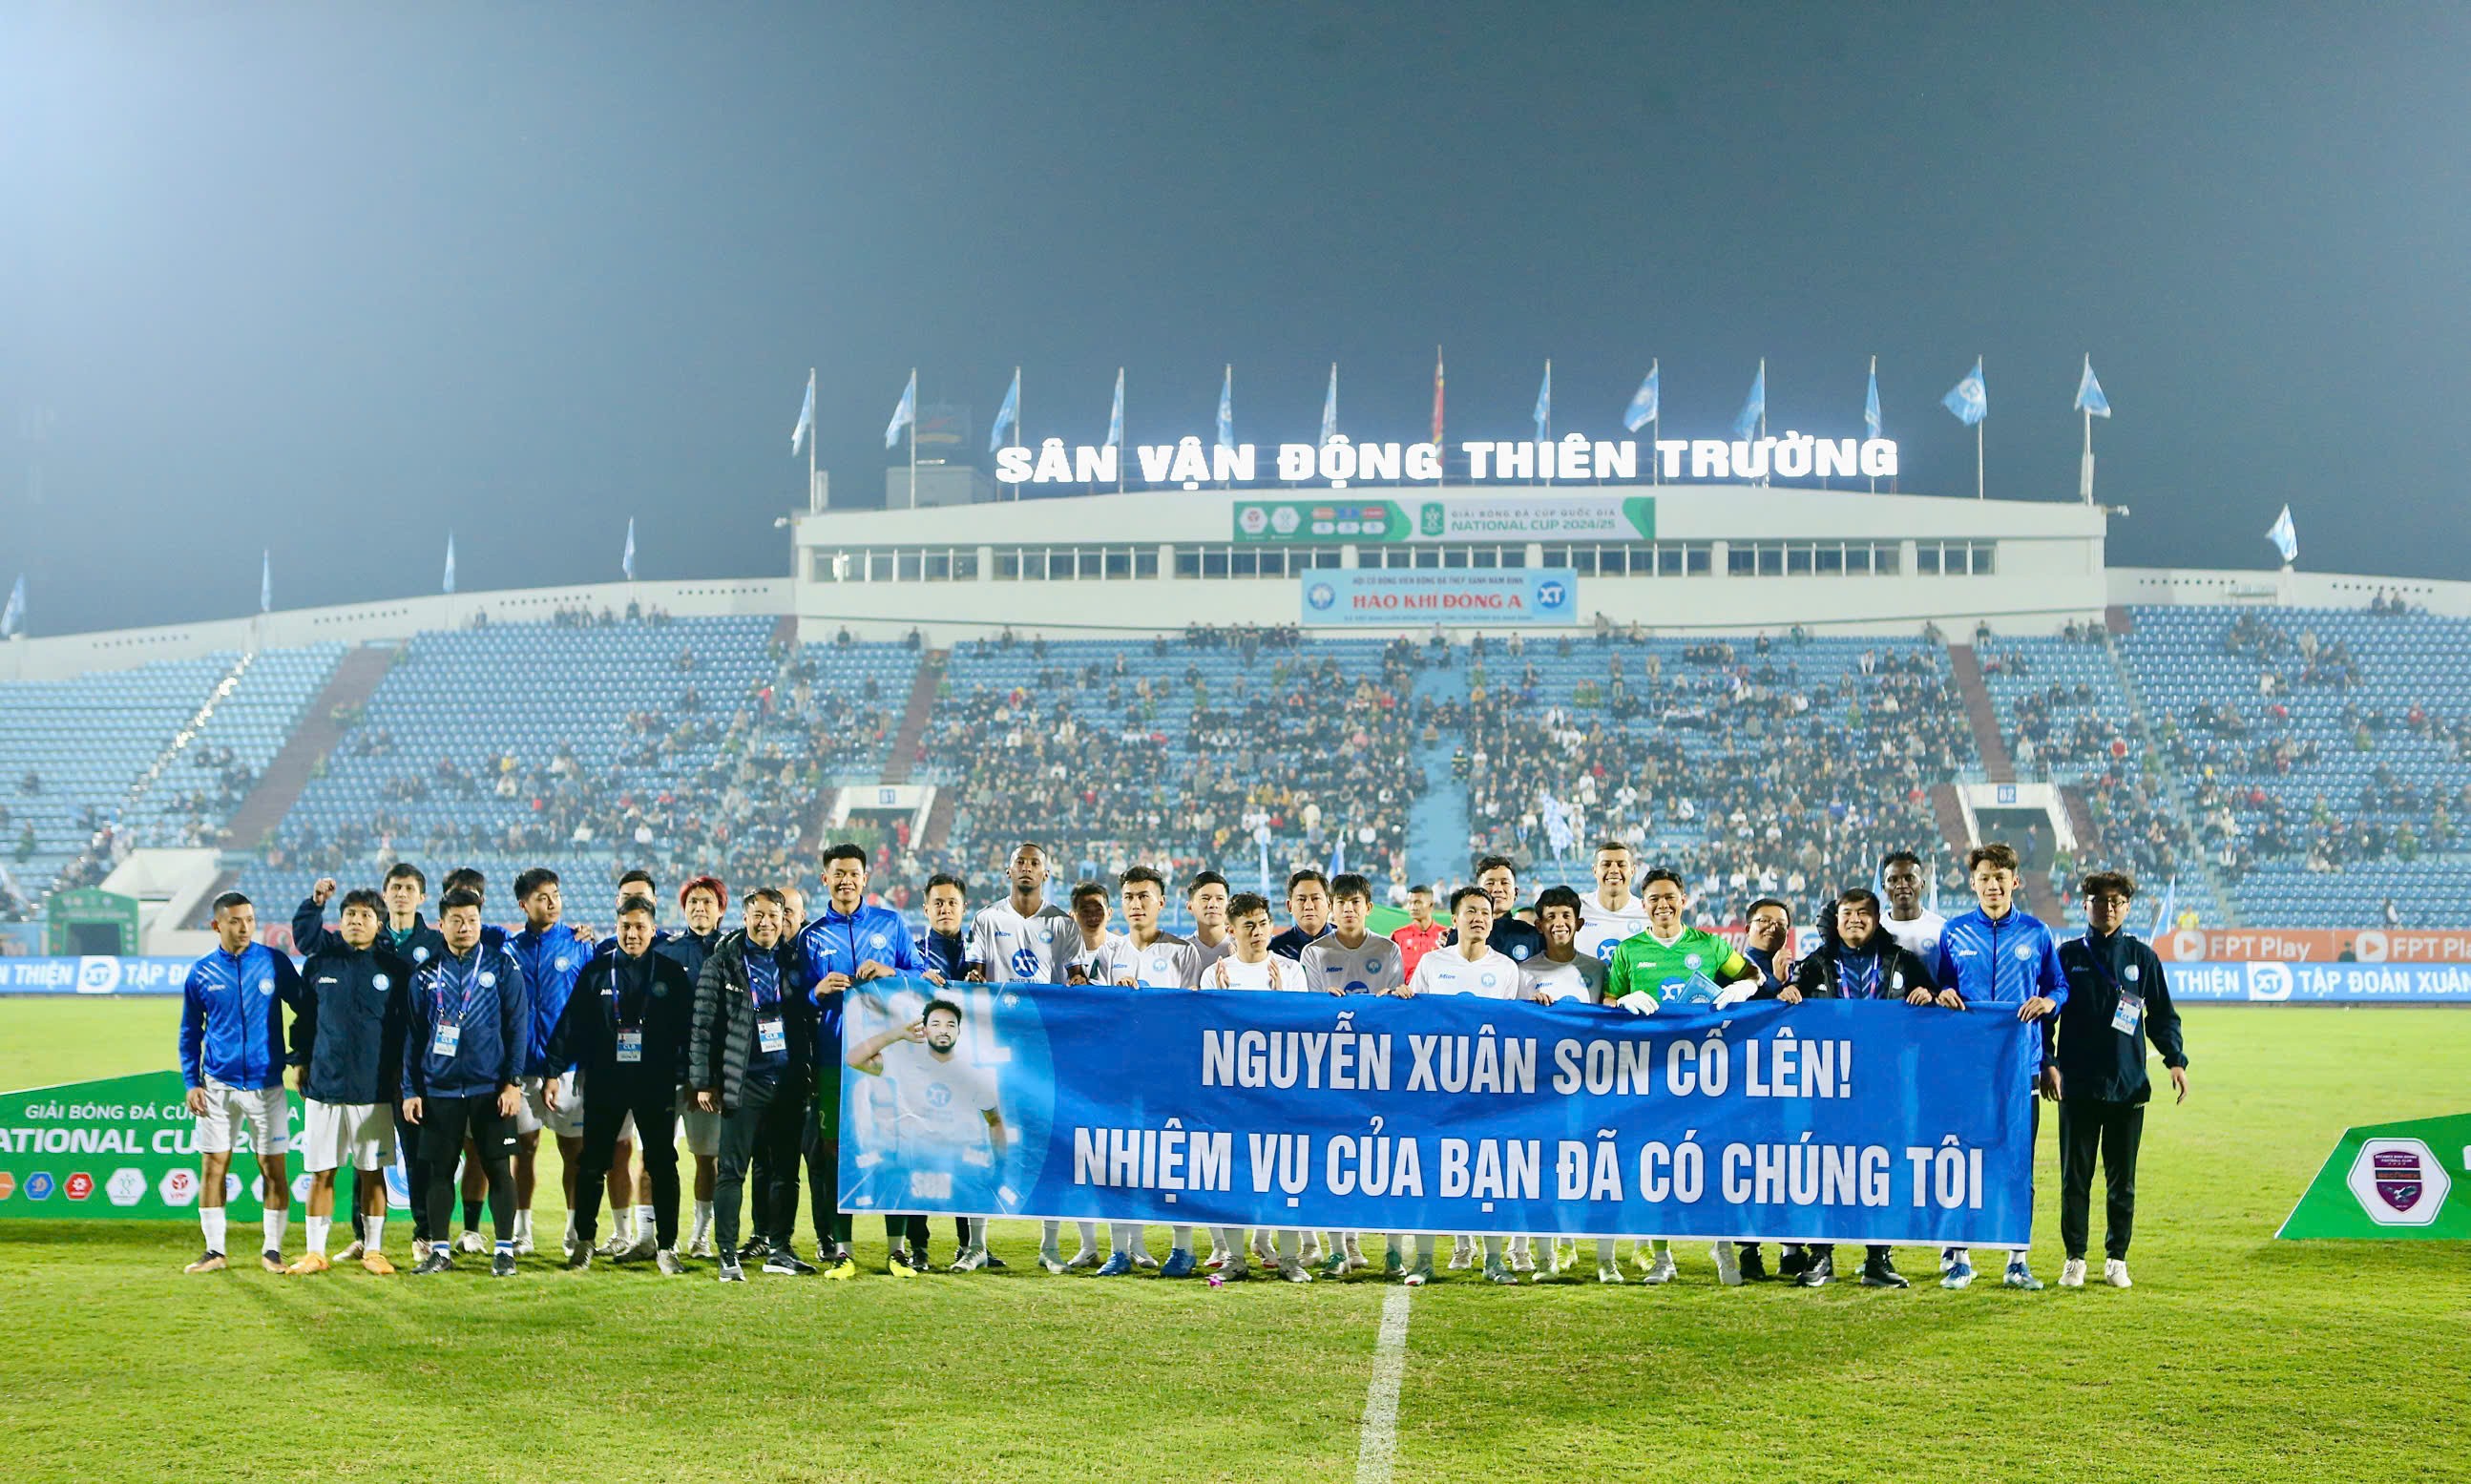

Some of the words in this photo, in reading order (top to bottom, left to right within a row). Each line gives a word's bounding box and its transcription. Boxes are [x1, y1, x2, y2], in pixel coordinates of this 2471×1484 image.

[995, 436, 1118, 483] SÂN
[1137, 435, 1256, 491] VẬN
[1276, 434, 1443, 489] ĐỘNG
[1462, 432, 1637, 479] THIÊN
[1656, 430, 1898, 478] TRƯỜNG
[1451, 520, 1527, 532] NATIONAL
[1530, 519, 1560, 531] CUP
[1507, 594, 1522, 609] A
[2210, 935, 2256, 958] FPT
[2261, 936, 2312, 963] Play
[2393, 937, 2440, 959] FPT
[14, 959, 73, 990] THIỆN
[125, 960, 165, 990] TẬP
[2173, 967, 2239, 995] THIỆN
[2298, 967, 2341, 997] TẬP
[2348, 966, 2410, 993] ĐOÀN
[1203, 1012, 1393, 1092] NGUYỄN
[1407, 1024, 1538, 1095] XUÂN
[1552, 1038, 1650, 1097] SON
[1665, 1020, 1731, 1097] CỐ
[1746, 1027, 1853, 1099] LÊN!
[25, 1099, 65, 1119] GIẢI
[69, 1101, 125, 1120] BÓNG
[130, 1101, 157, 1119] ĐÁ
[152, 1129, 200, 1154] CU
[1074, 1118, 1233, 1203] NHIỆM
[1248, 1133, 1310, 1208] VỤ
[1327, 1115, 1425, 1198] CỦA
[1439, 1138, 1541, 1214] BẠN
[1556, 1129, 1624, 1202] ĐÃ
[1640, 1129, 1705, 1204] CÓ
[1722, 1131, 1891, 1209] CHÚNG
[1906, 1135, 1984, 1210] TÔI
